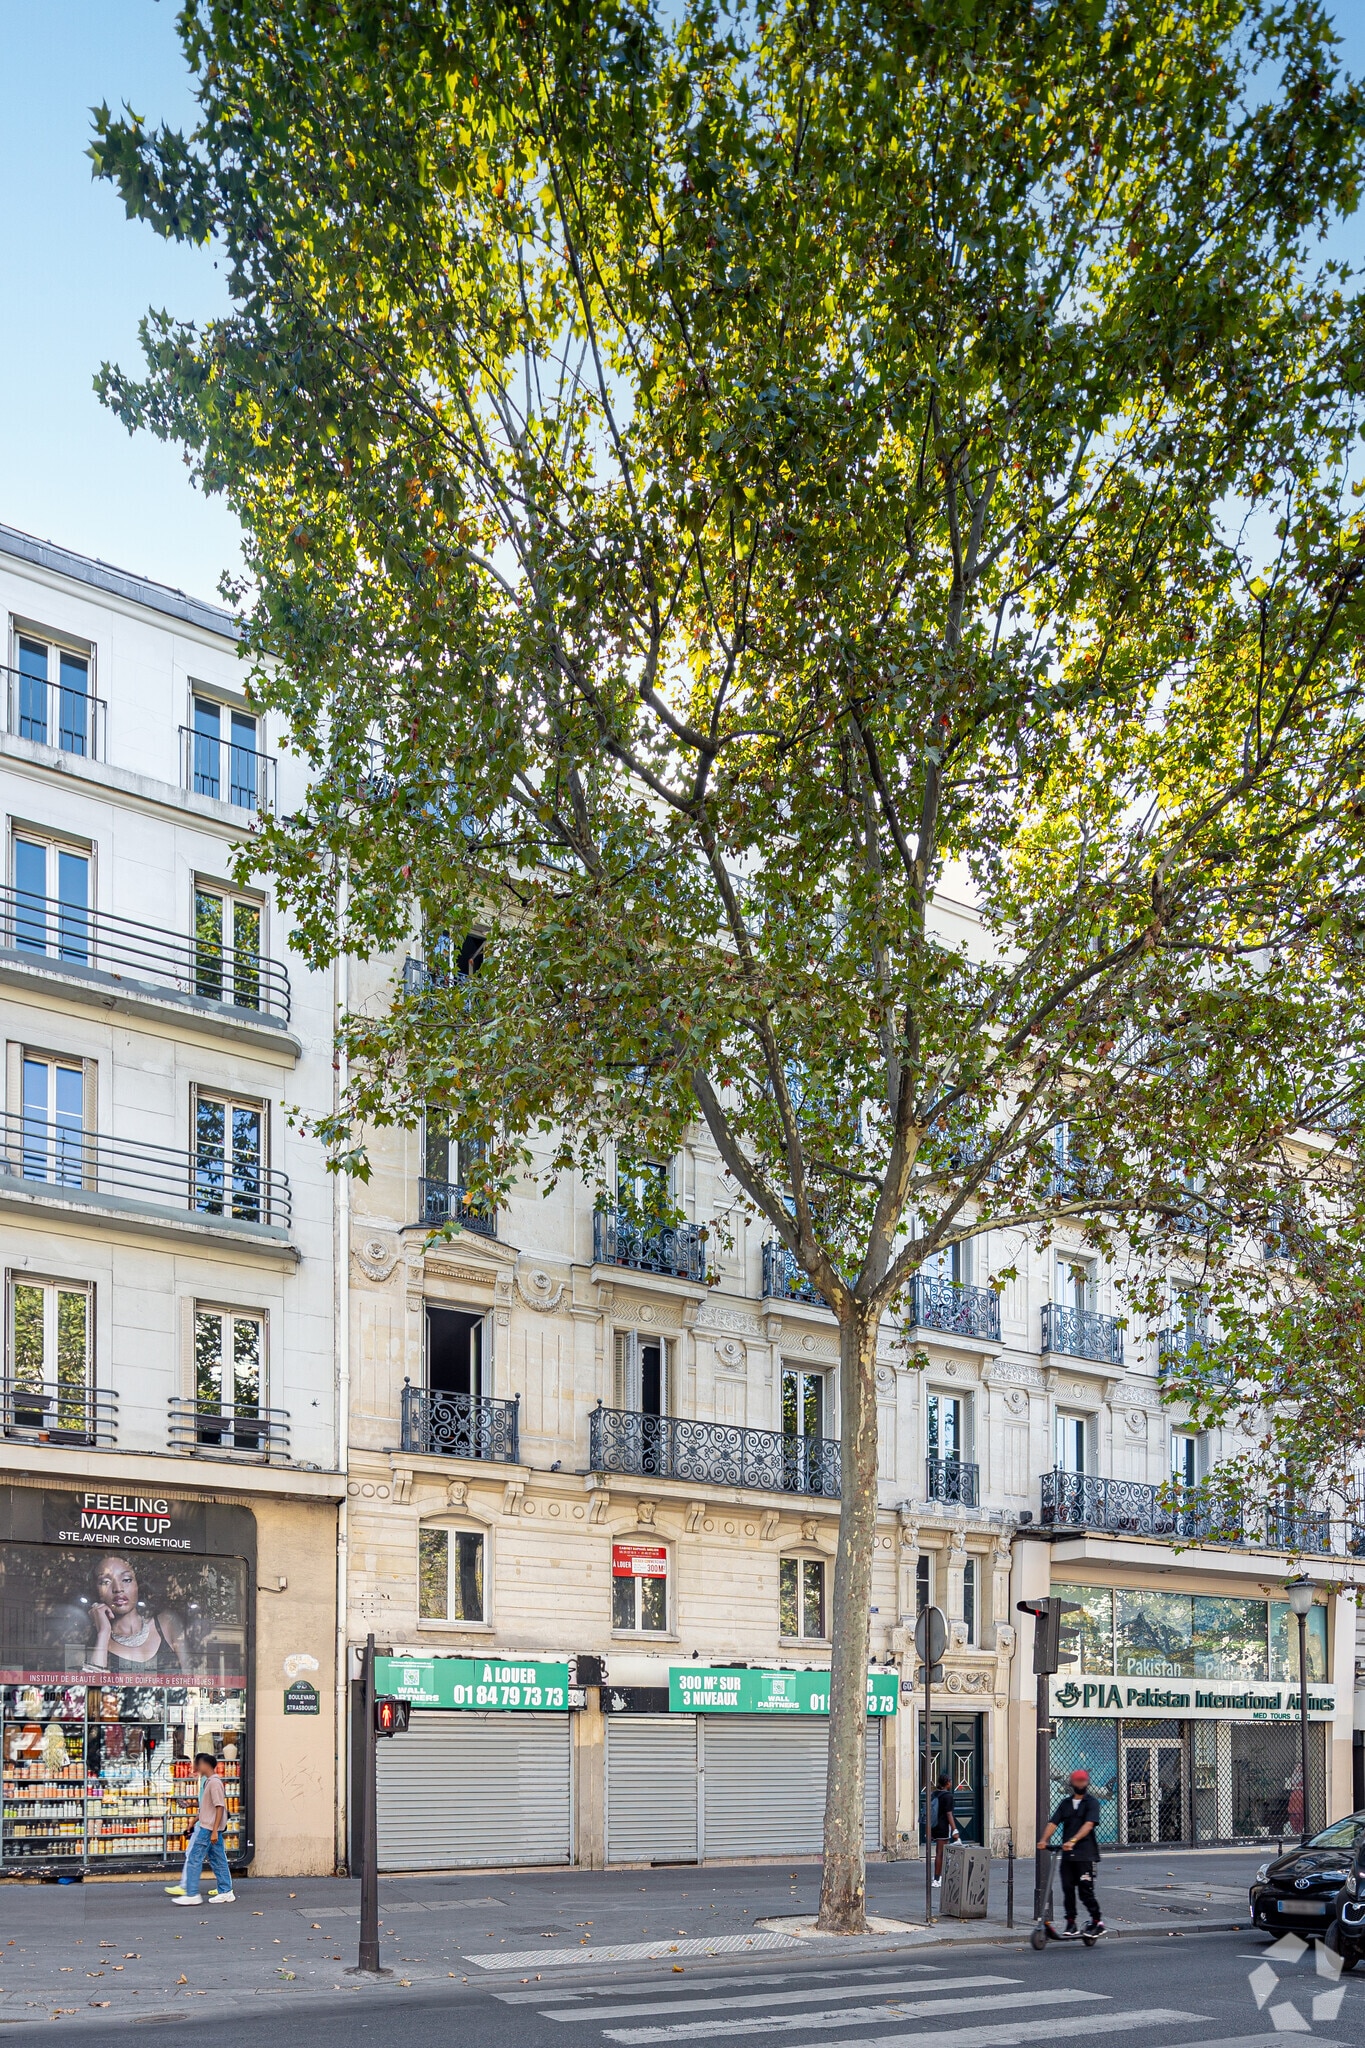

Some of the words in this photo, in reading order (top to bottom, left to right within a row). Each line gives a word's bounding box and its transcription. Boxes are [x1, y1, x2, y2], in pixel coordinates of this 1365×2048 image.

[84, 1493, 168, 1514] FEELING
[81, 1513, 138, 1532] MAKE
[144, 1518, 171, 1534] UP
[59, 1531, 120, 1544] STE.AVENIR
[123, 1535, 191, 1549] COSMETIQUE
[617, 1560, 631, 1569] LOUER
[483, 1664, 493, 1683] À
[495, 1667, 536, 1684] LOUER
[1127, 1657, 1181, 1677] Pakistan
[29, 1674, 59, 1683] INSTITUT
[60, 1675, 69, 1683] DE
[125, 1676, 133, 1684] DE
[679, 1675, 701, 1690] 300
[703, 1676, 718, 1690] M²
[720, 1676, 741, 1690] SUR
[385, 1694, 440, 1702] ARTNERS
[397, 1687, 426, 1695] WALL
[453, 1684, 473, 1704] 01
[476, 1685, 498, 1705] 84
[501, 1686, 520, 1706] 79
[523, 1687, 542, 1706] 73
[545, 1687, 564, 1706] 73
[683, 1691, 691, 1705] 3
[693, 1691, 738, 1706] NIVEAUX
[1082, 1683, 1123, 1709] PIA
[1127, 1687, 1190, 1708] Pakistan
[1195, 1690, 1281, 1710] International
[757, 1701, 800, 1709] PARTNERS
[810, 1693, 825, 1711] 01
[880, 1695, 894, 1712] 73
[1270, 1712, 1290, 1720] TOURS
